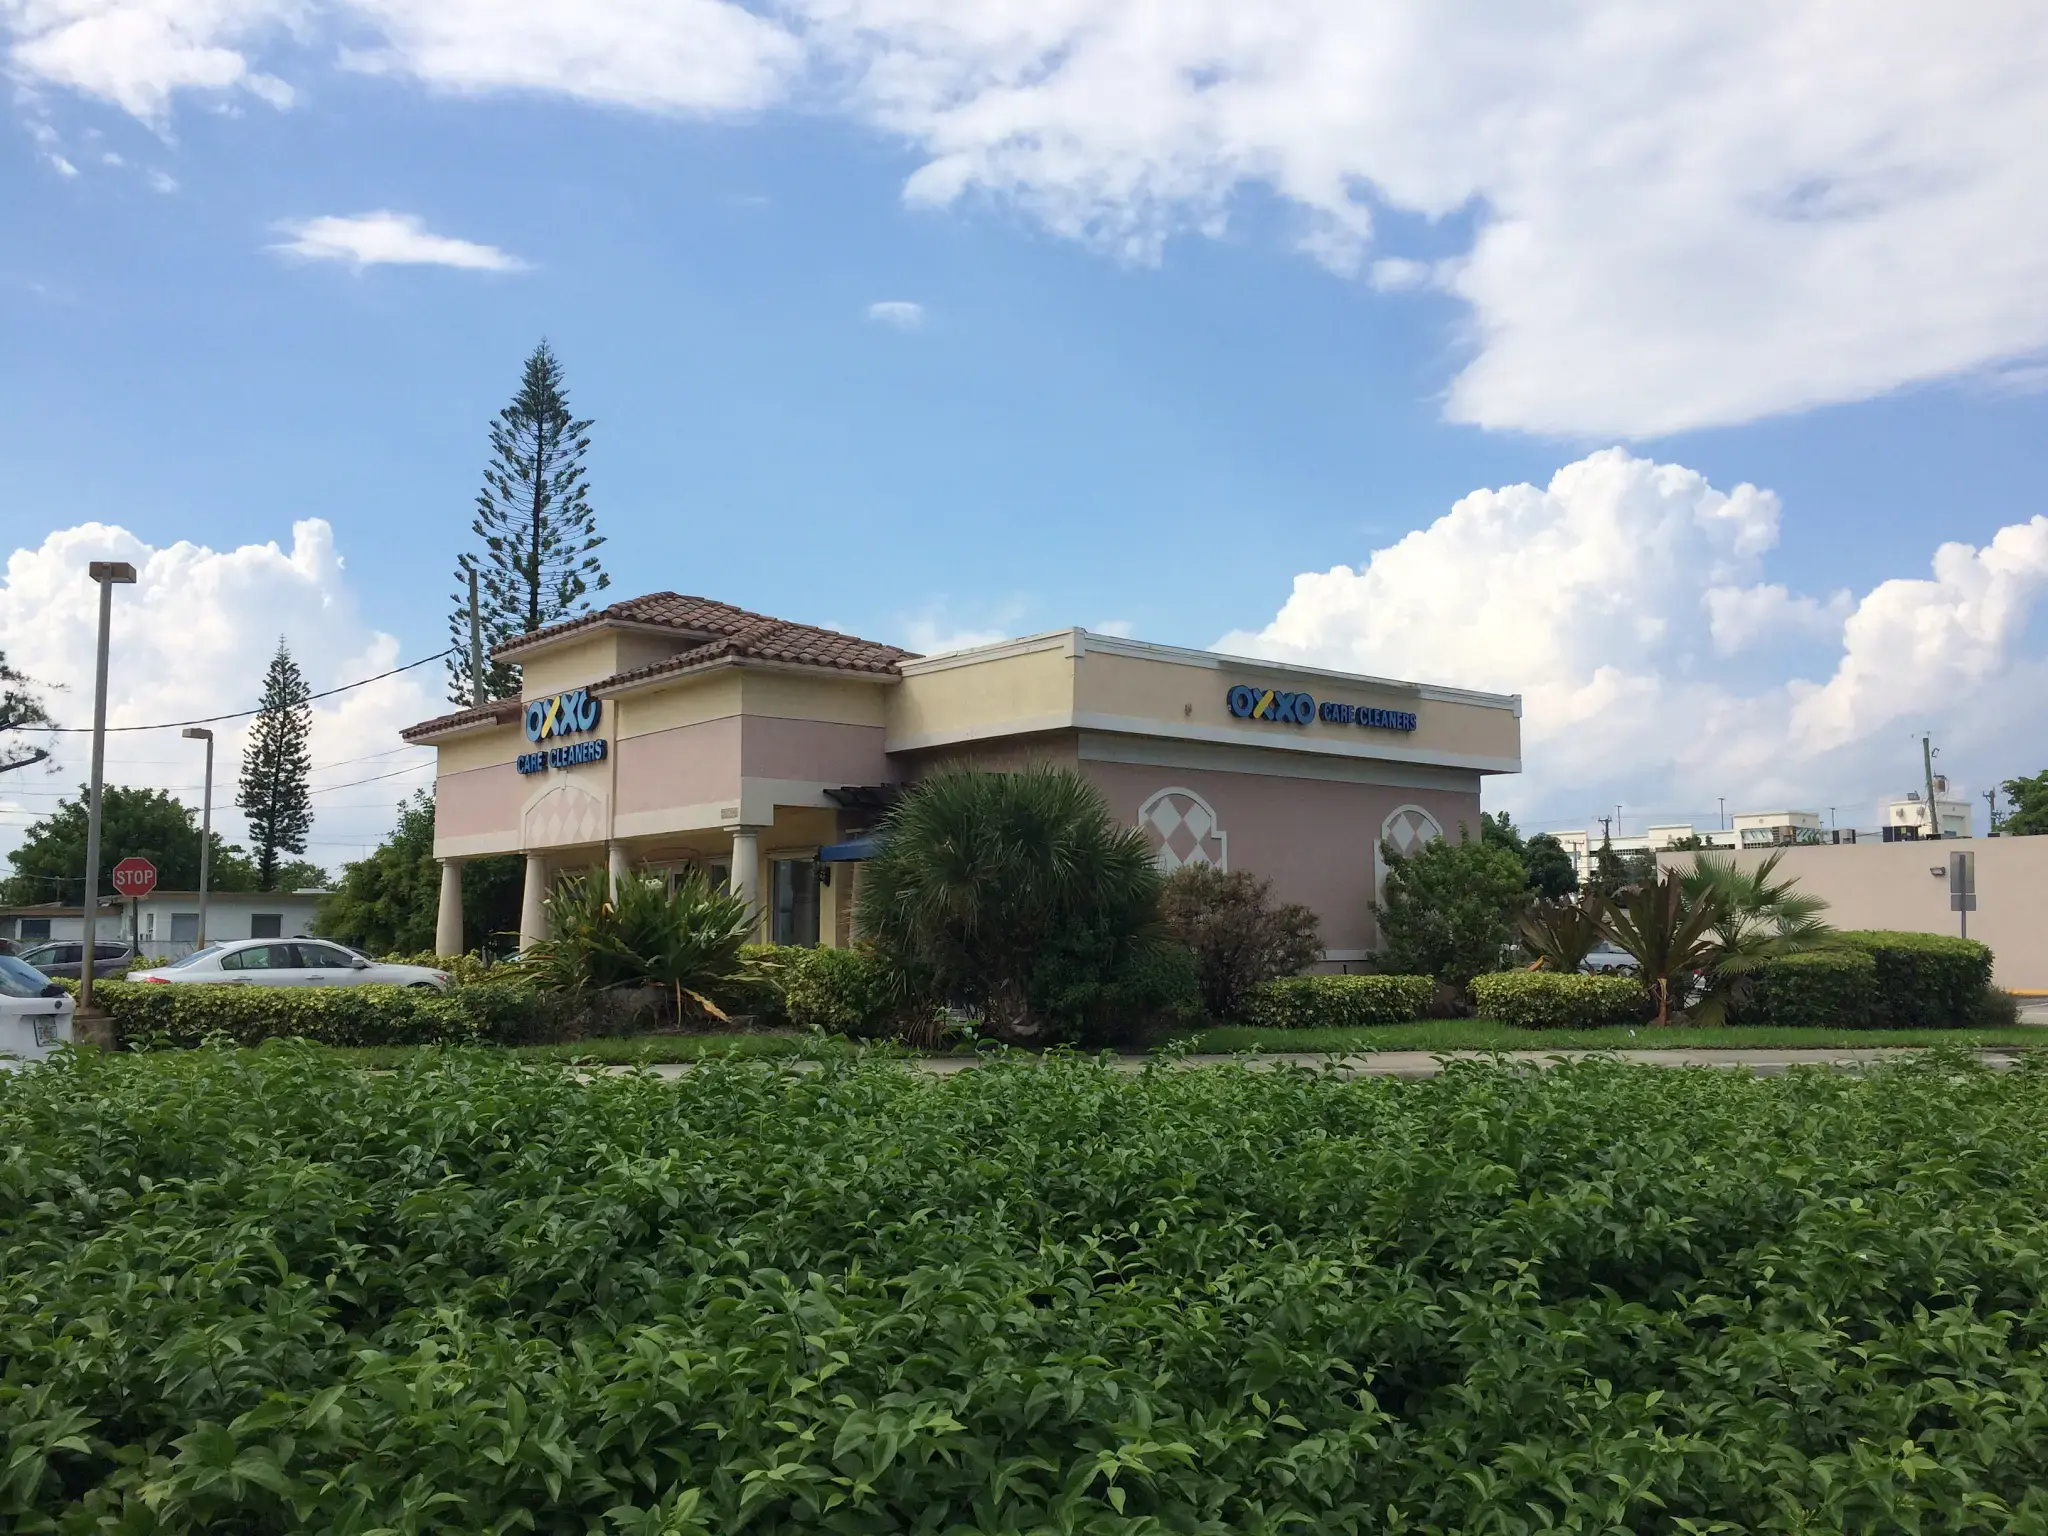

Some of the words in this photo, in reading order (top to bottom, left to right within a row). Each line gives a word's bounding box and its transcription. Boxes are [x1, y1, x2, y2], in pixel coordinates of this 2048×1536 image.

[526, 687, 600, 743] OXXO
[1229, 684, 1315, 725] OXXO
[1321, 702, 1355, 724] CARE
[1357, 706, 1417, 731] CLEANERS
[517, 751, 546, 774] CARE
[550, 739, 606, 768] CLEANERS
[116, 869, 154, 885] STOP
